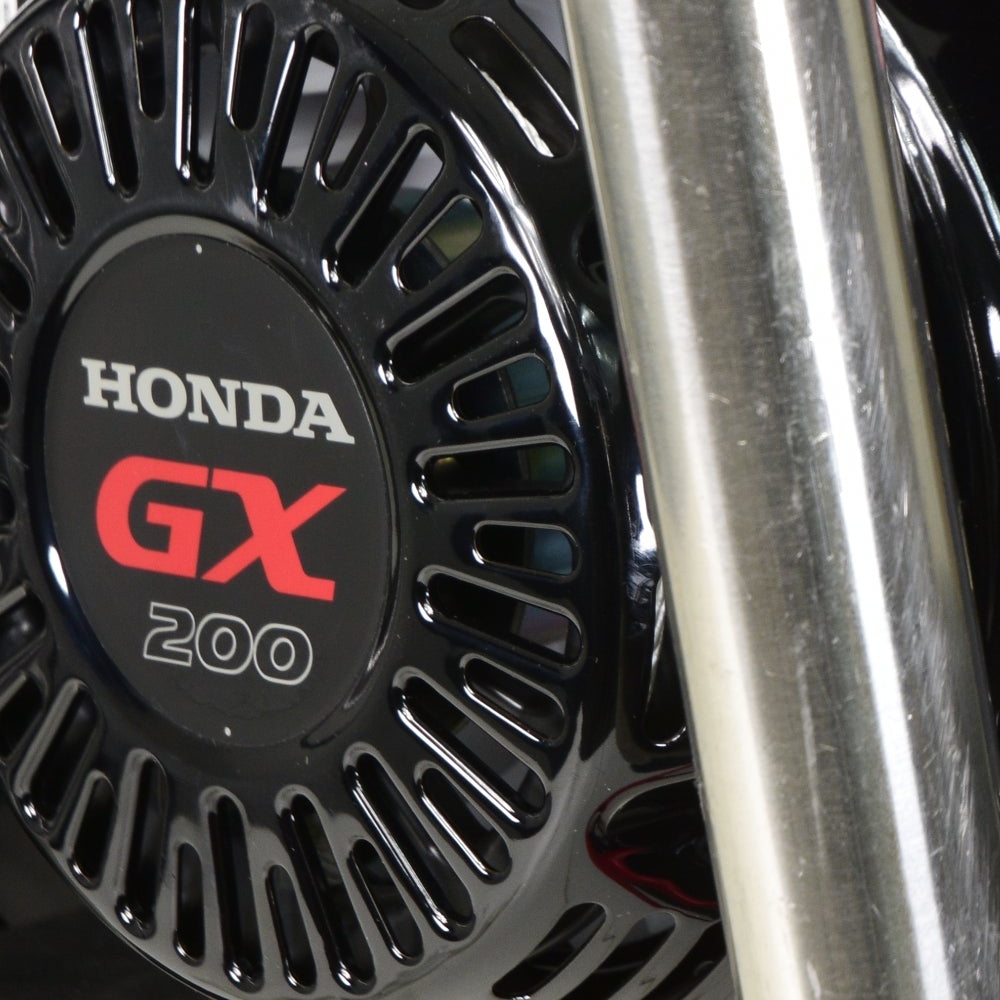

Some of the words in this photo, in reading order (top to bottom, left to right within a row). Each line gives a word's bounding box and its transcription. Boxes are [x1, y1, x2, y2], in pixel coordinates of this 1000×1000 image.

[80, 357, 356, 445] HONDA
[95, 454, 348, 603] GX
[142, 601, 314, 686] 200
